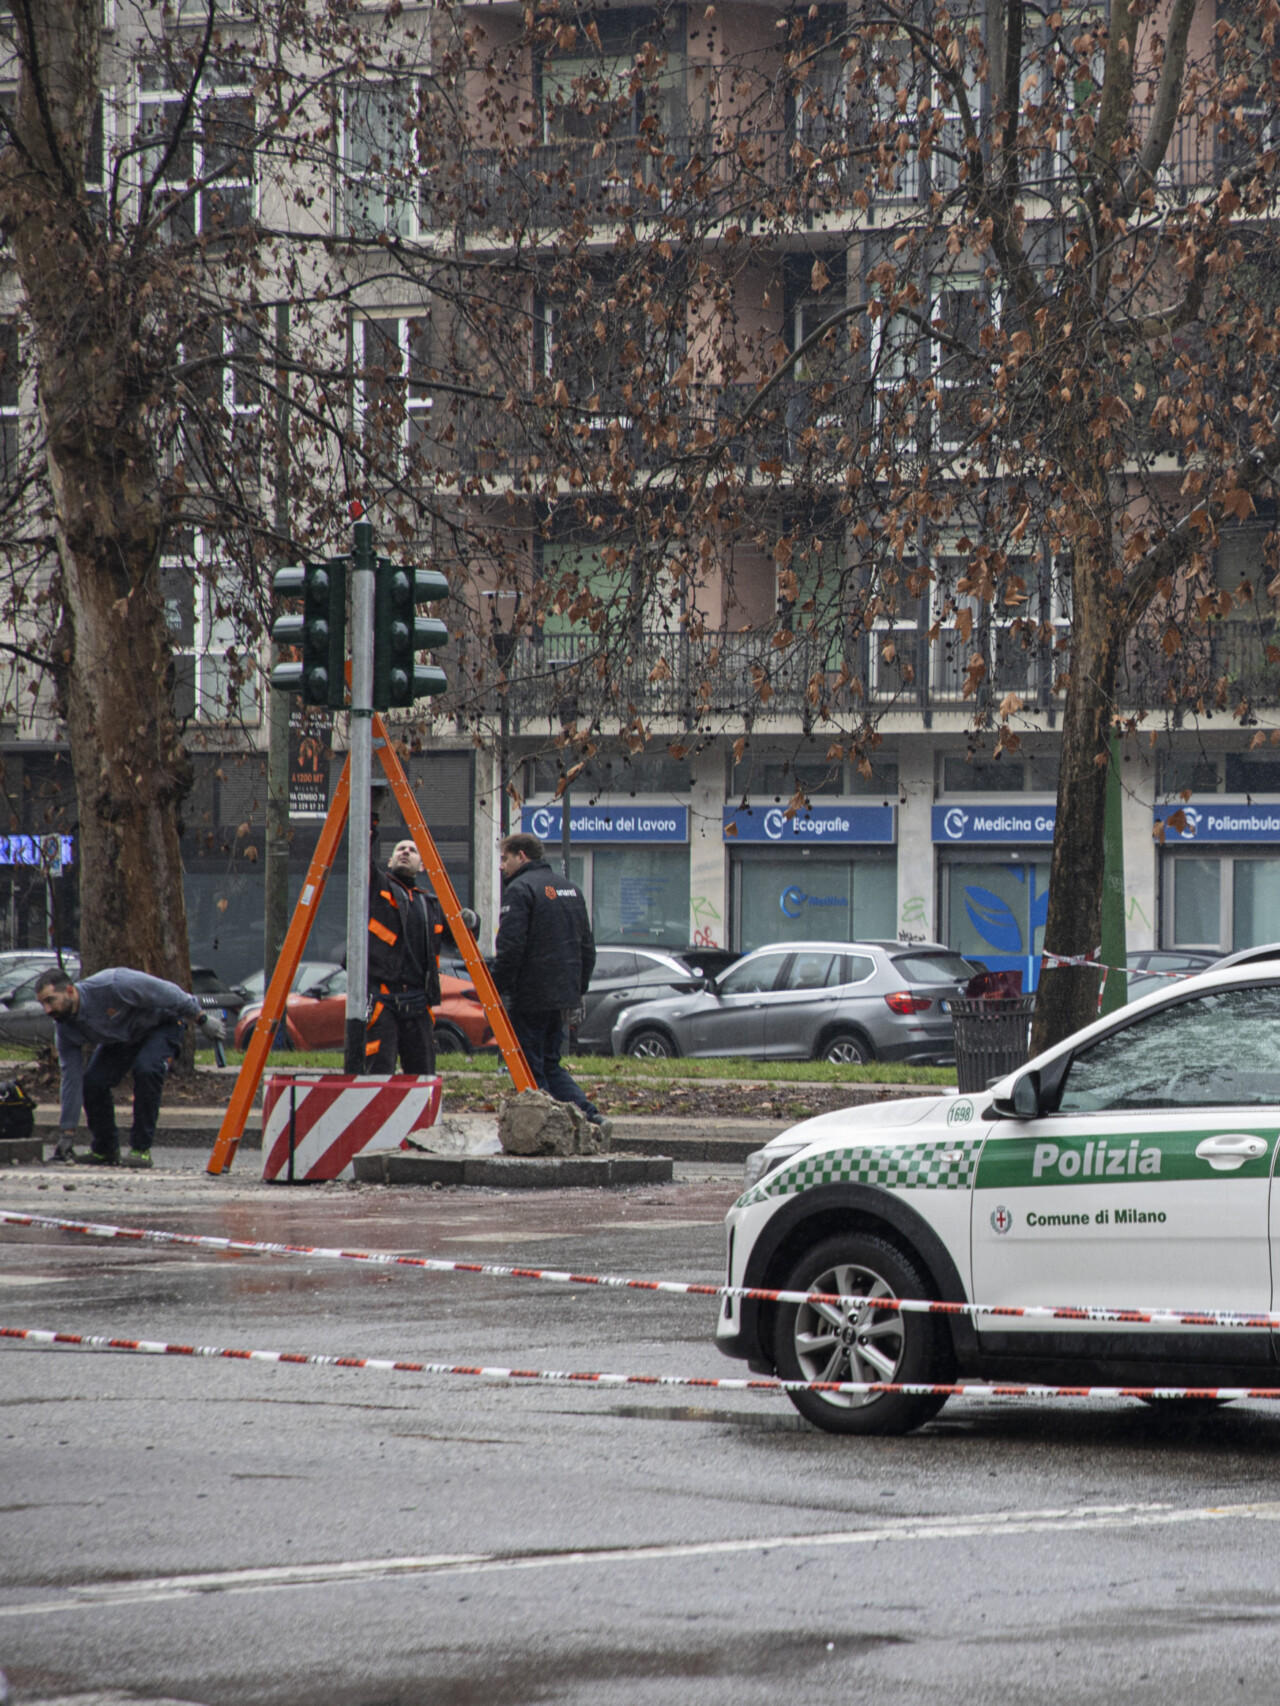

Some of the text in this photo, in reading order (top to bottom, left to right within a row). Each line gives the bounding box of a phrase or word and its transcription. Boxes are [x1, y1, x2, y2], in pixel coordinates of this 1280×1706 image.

[616, 817, 634, 831] del
[638, 817, 676, 831] Lavoro
[793, 817, 849, 835] Ecografie
[973, 817, 1056, 831] Medicina Ge
[950, 1107, 971, 1122] 1698
[1032, 1139, 1162, 1177] Polizia
[1026, 1208, 1167, 1227] Comune di Milano
